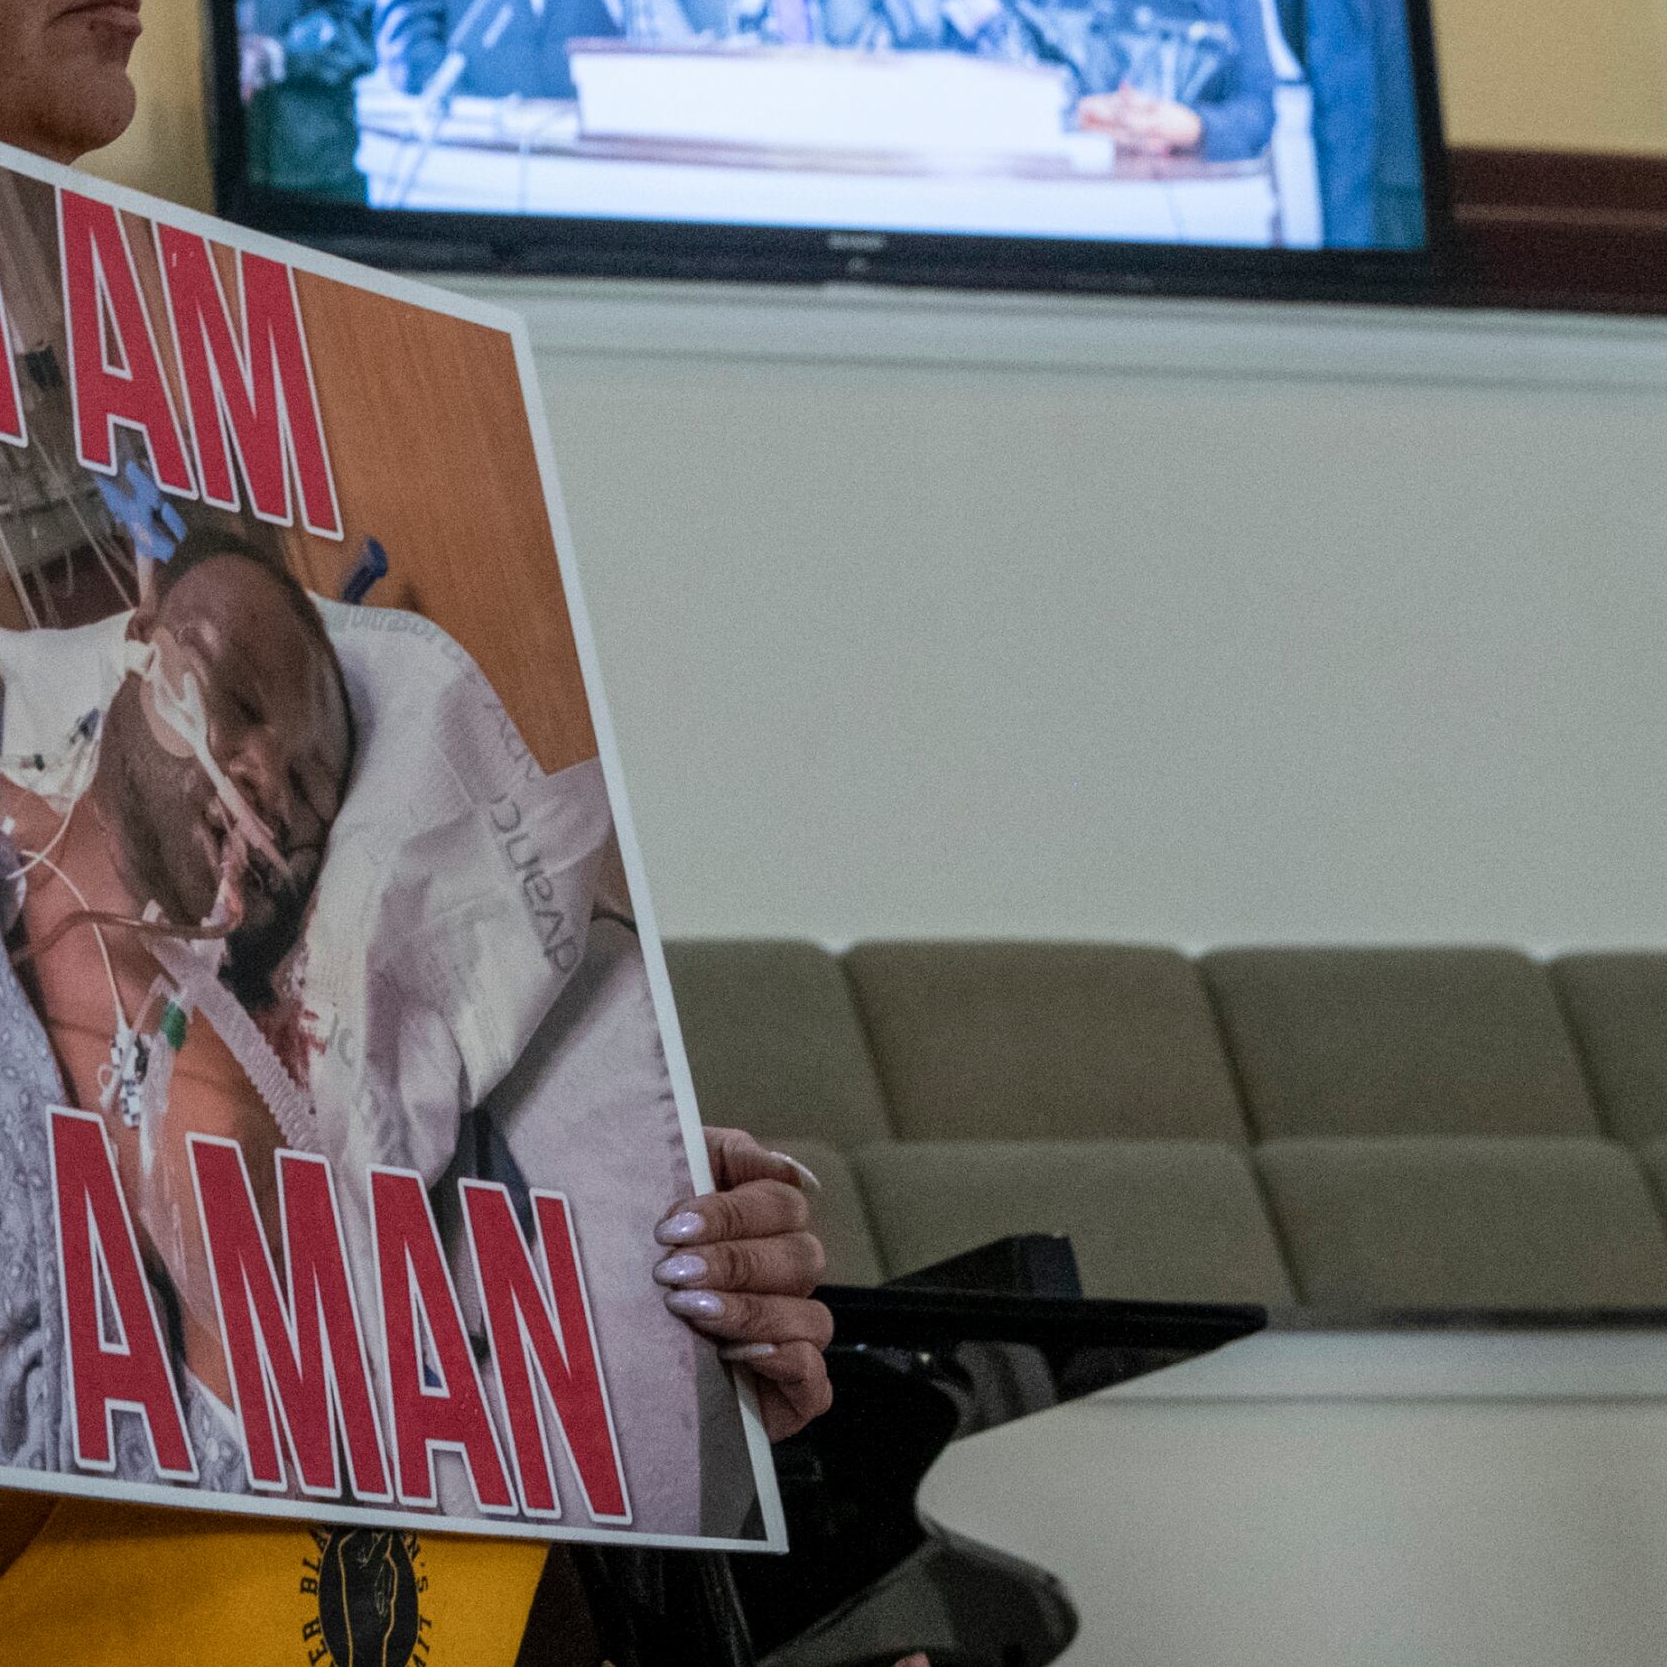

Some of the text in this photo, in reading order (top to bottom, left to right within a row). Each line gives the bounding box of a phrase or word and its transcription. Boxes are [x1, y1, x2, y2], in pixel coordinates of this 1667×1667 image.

[55, 185, 344, 542] AM
[46, 1104, 633, 1526] A MAN
